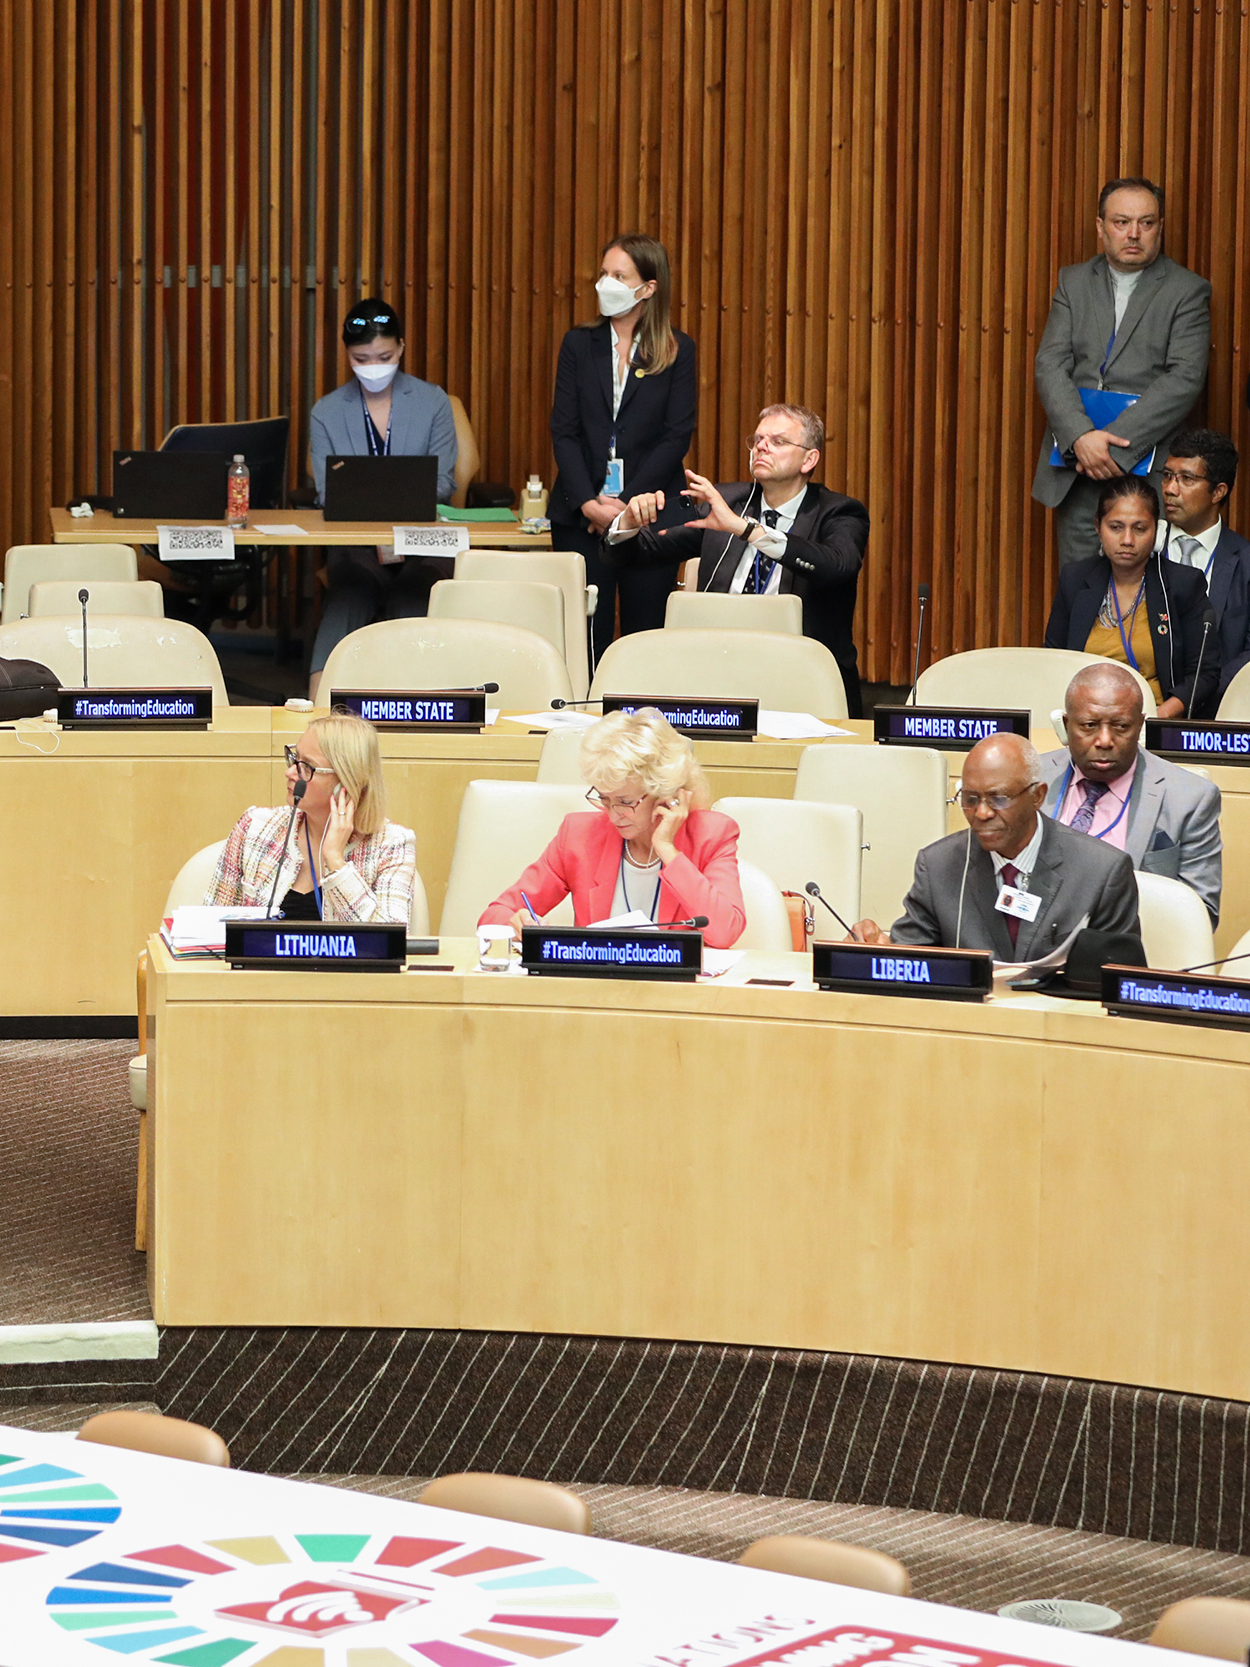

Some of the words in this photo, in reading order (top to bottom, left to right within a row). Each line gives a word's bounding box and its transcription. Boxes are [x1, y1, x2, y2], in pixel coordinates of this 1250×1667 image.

[75, 699, 195, 718] #TransformingEducation
[361, 700, 413, 720] MEMBER
[415, 701, 454, 720] STATE
[904, 717, 957, 738] MEMBER
[958, 719, 998, 739] STATE
[1180, 731, 1250, 753] TIMOR-LES
[275, 934, 357, 957] LITHUANIA
[542, 940, 681, 964] #TransformingEducation
[871, 957, 931, 983] LIBERIA
[1120, 981, 1250, 1012] #TransformingEducation
